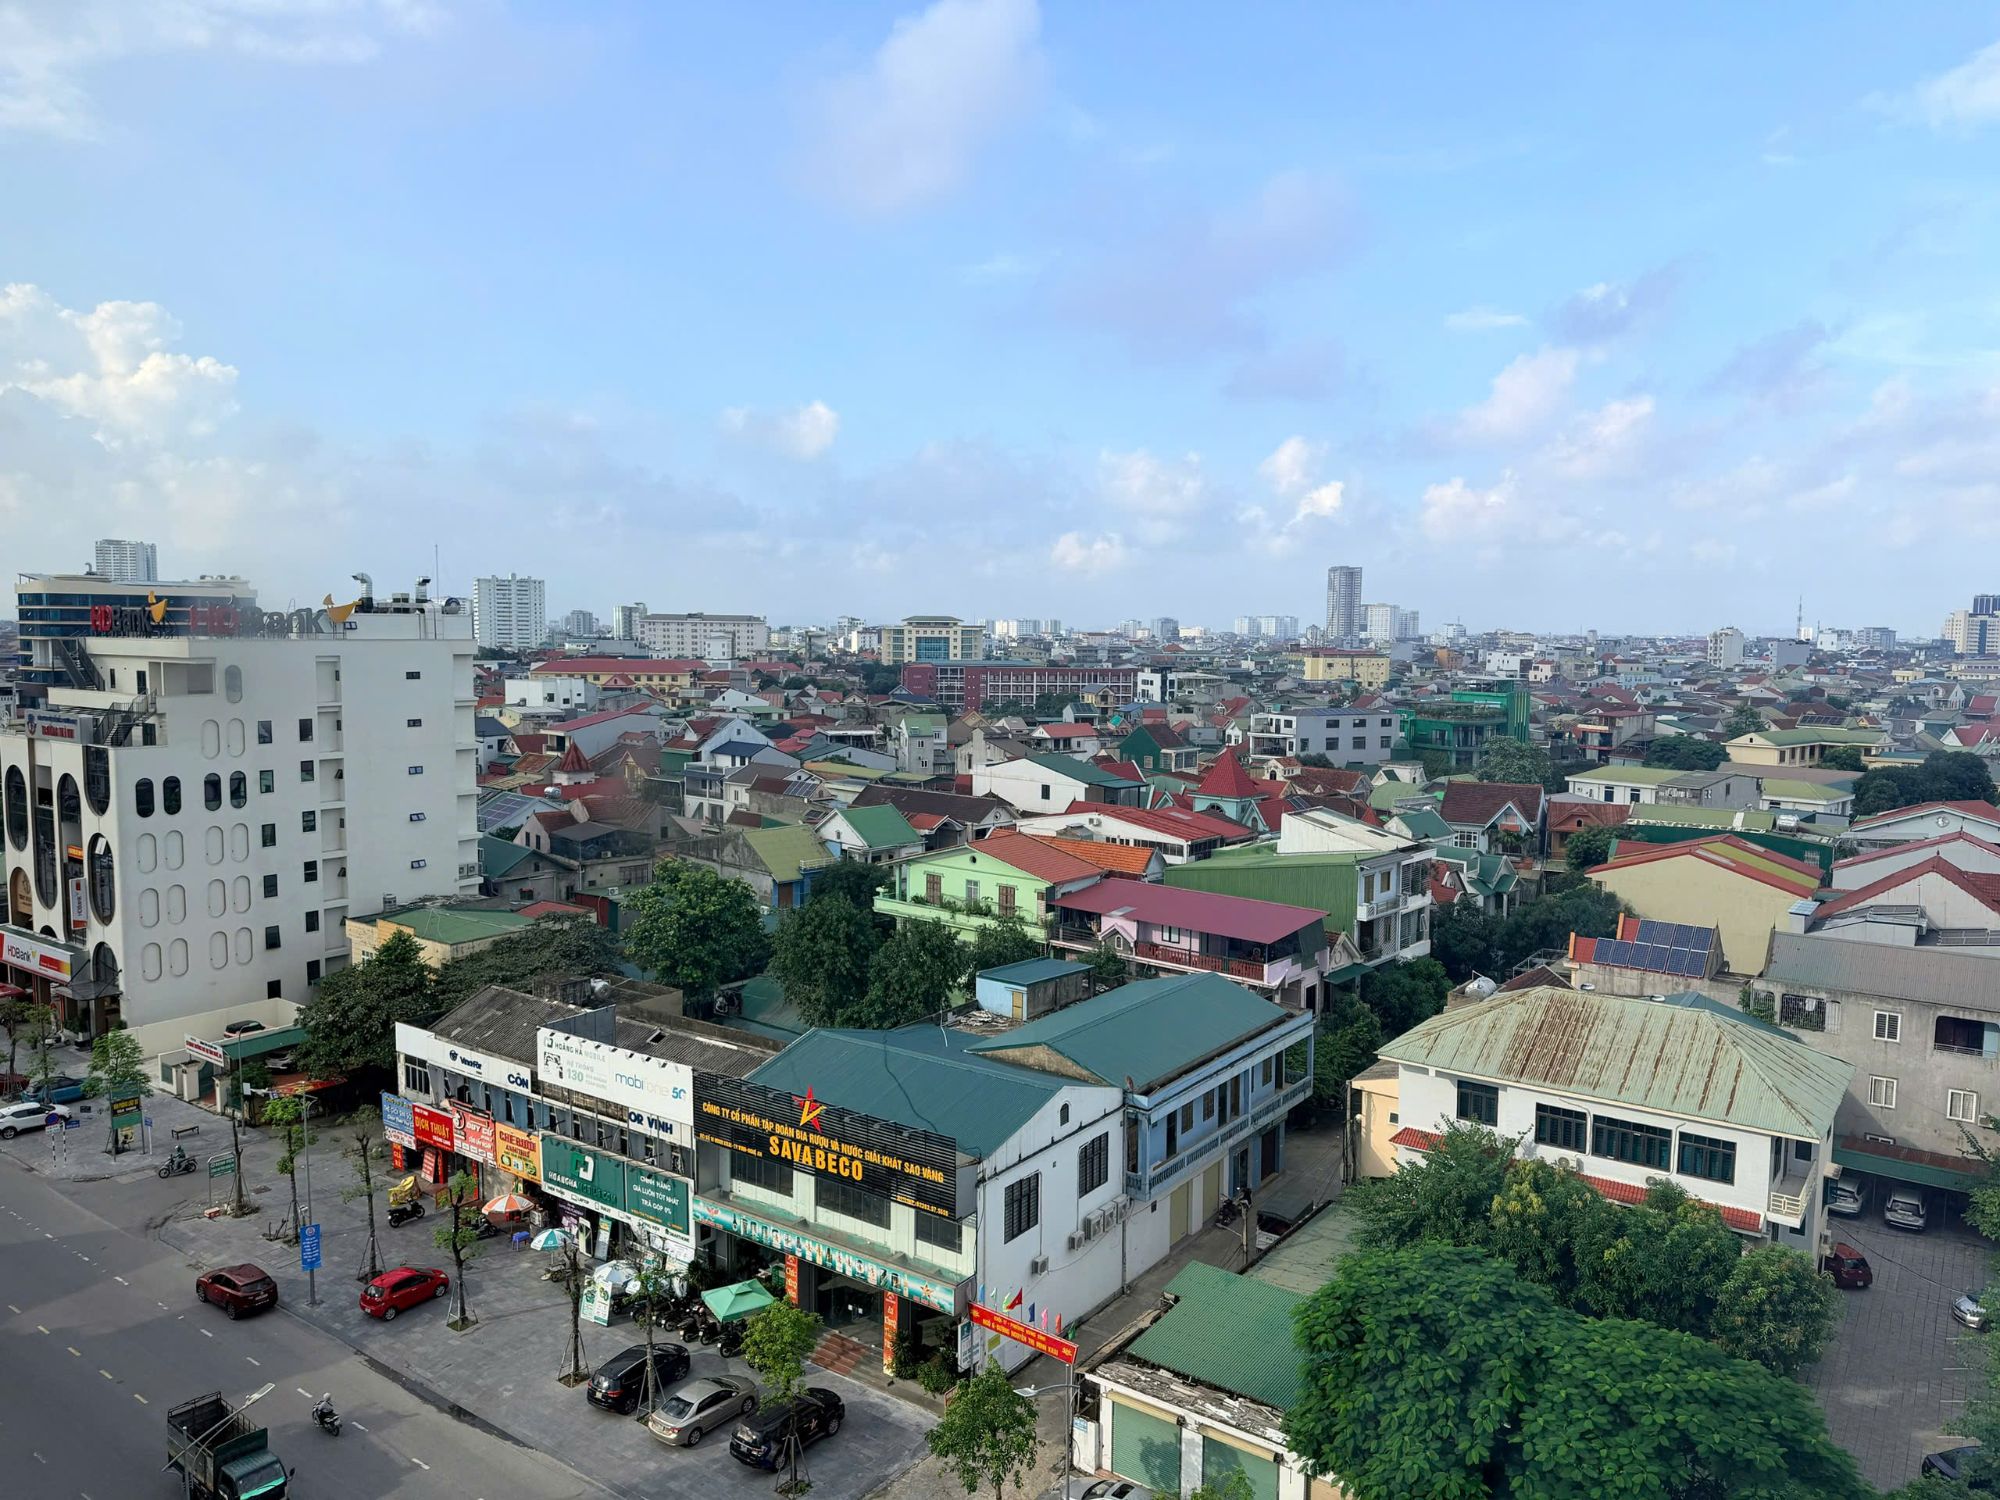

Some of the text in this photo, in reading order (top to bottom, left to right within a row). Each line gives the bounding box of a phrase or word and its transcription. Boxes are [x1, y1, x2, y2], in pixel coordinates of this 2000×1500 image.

[91, 605, 152, 632] HDBank
[190, 604, 326, 635] HDBank
[8, 944, 31, 962] HDBank
[567, 1068, 584, 1082] 130
[628, 1111, 673, 1135] OR VINH
[702, 1101, 720, 1116] CÔNG
[721, 1107, 730, 1119] TY
[796, 1129, 808, 1142] BIA
[904, 1162, 920, 1177] SAO
[921, 1165, 944, 1183] VÀNG
[769, 1135, 863, 1181] SAVABECO
[641, 1187, 656, 1198] LUÔN
